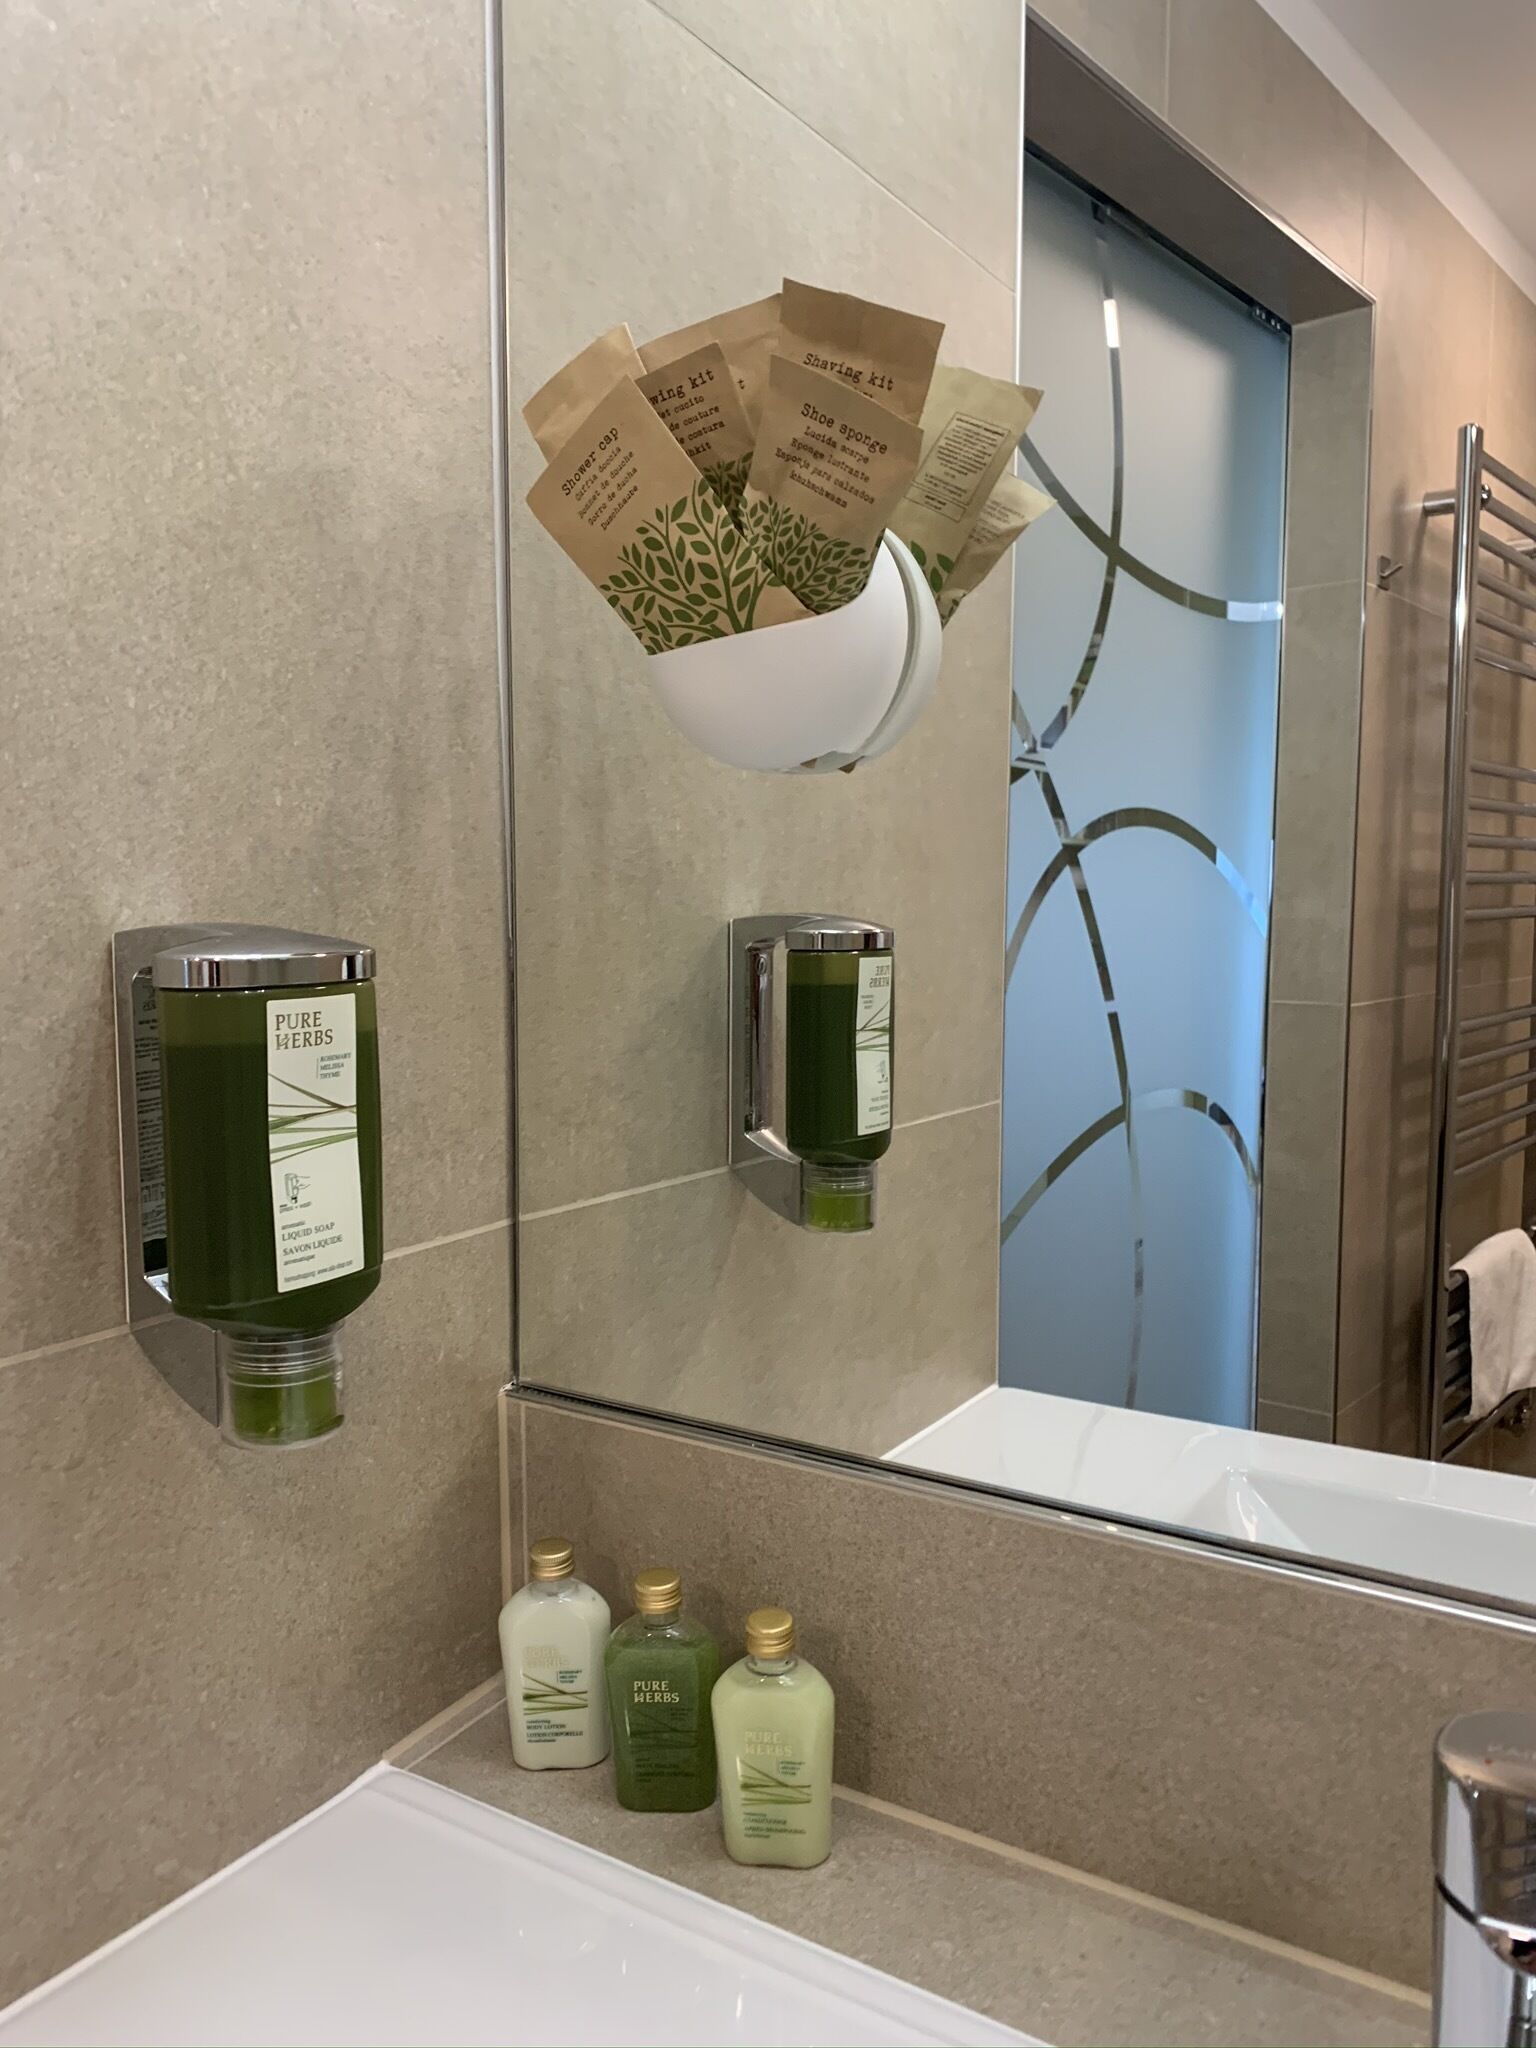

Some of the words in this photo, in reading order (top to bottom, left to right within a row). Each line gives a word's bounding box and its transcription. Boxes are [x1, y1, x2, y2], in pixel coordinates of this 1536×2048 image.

[802, 352, 864, 384] Shaving
[867, 371, 894, 391] kit
[648, 384, 686, 406] wing
[688, 368, 714, 390] kit
[674, 395, 705, 414] cucito
[682, 405, 720, 426] couture
[687, 420, 725, 441] costura
[800, 402, 835, 428] Shoe
[839, 423, 888, 455] sponge
[803, 425, 837, 449] Lucida
[840, 443, 870, 465] scarpe
[561, 450, 597, 497] Shower
[598, 427, 619, 451] cap
[600, 479, 610, 491] de
[609, 450, 634, 480] douche
[574, 473, 599, 502] Cuffia
[598, 446, 622, 473] doccia
[607, 491, 616, 502] de
[616, 467, 638, 492] ducha
[810, 466, 832, 482] para
[274, 1010, 322, 1031] PURE
[274, 1028, 334, 1051] HERBS
[281, 1227, 313, 1242] LIQUID
[314, 1221, 336, 1234] SOAP
[282, 1243, 312, 1256] SAVON
[312, 1233, 344, 1249] LIQUIDE
[633, 1680, 670, 1692] PURE
[633, 1692, 680, 1703] HERBS
